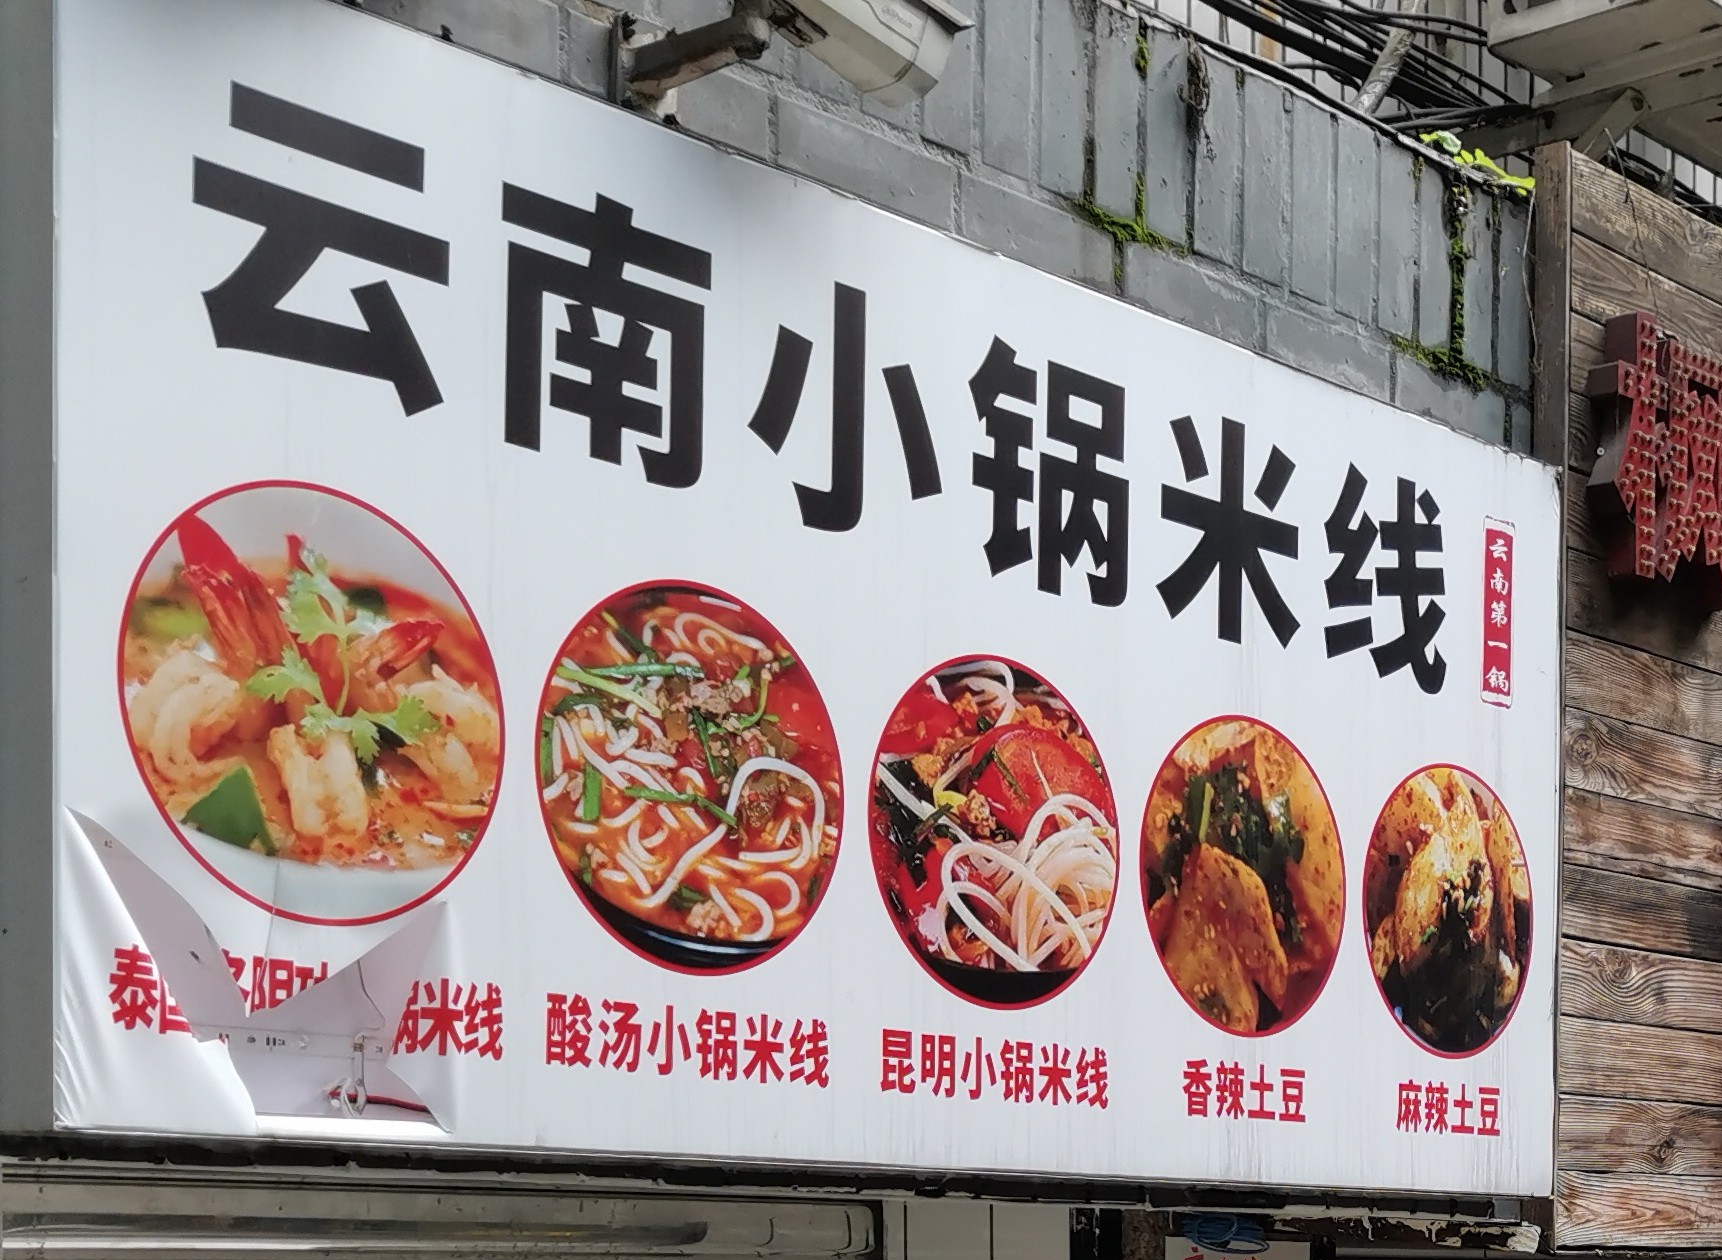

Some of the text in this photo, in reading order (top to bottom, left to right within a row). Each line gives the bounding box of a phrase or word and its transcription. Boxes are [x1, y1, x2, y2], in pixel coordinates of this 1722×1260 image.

[193, 80, 1447, 695] 云南小锅米线
[1485, 538, 1509, 693] 云南第一锅
[545, 992, 830, 1089] 酸汤小锅米线
[879, 1027, 1109, 1110] 昆明小锅米线
[1182, 1058, 1306, 1123] 香辣土豆
[1396, 1080, 1501, 1137] 麻辣土豆
